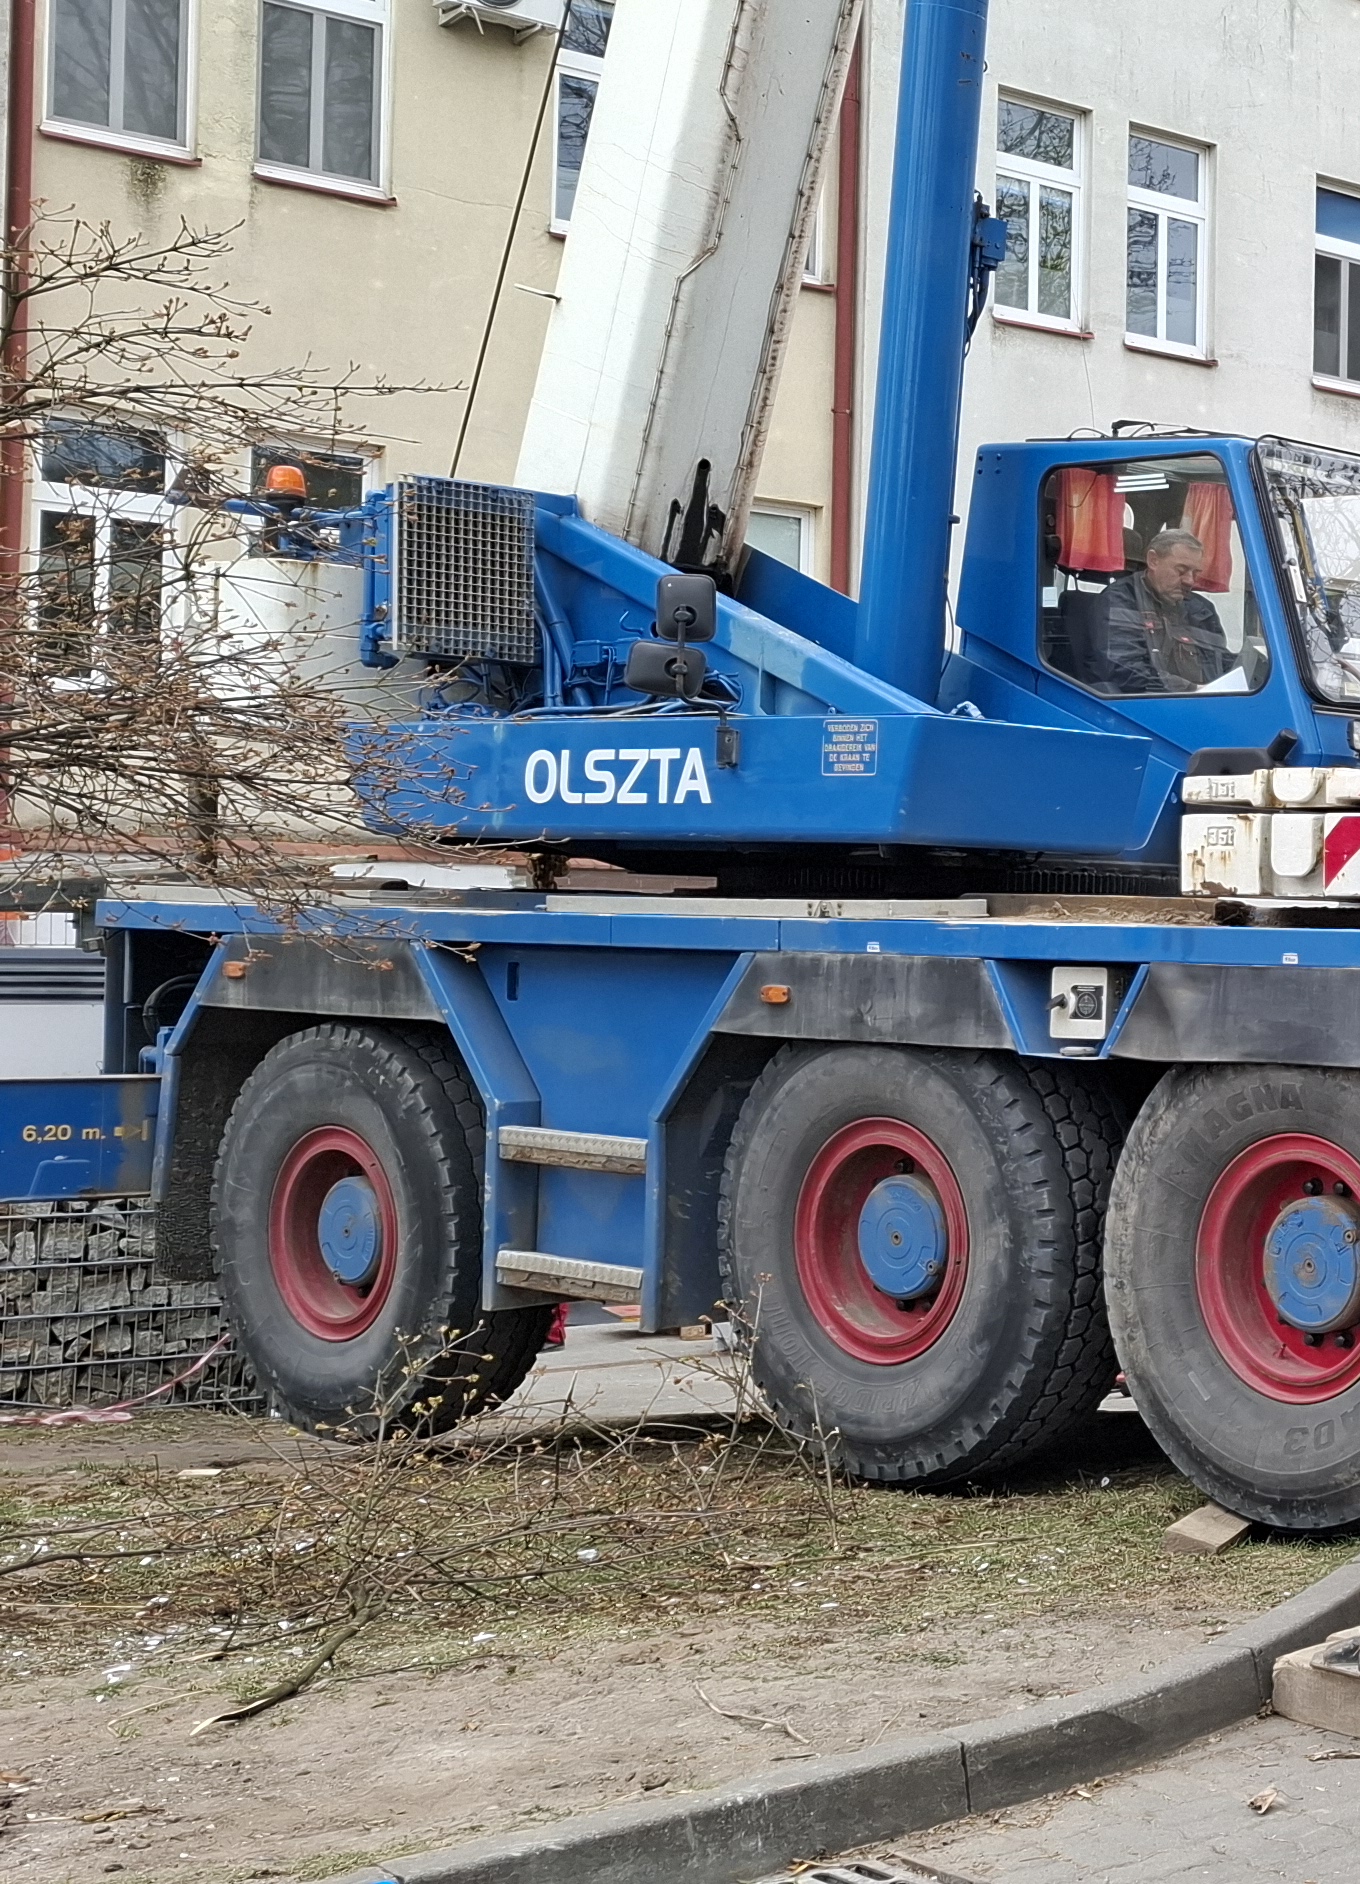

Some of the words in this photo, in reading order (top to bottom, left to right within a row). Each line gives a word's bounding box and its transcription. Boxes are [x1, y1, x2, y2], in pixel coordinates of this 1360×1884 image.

[524, 747, 712, 804] OLSZTA
[22, 1124, 72, 1144] 6,20
[81, 1127, 107, 1140] m.
